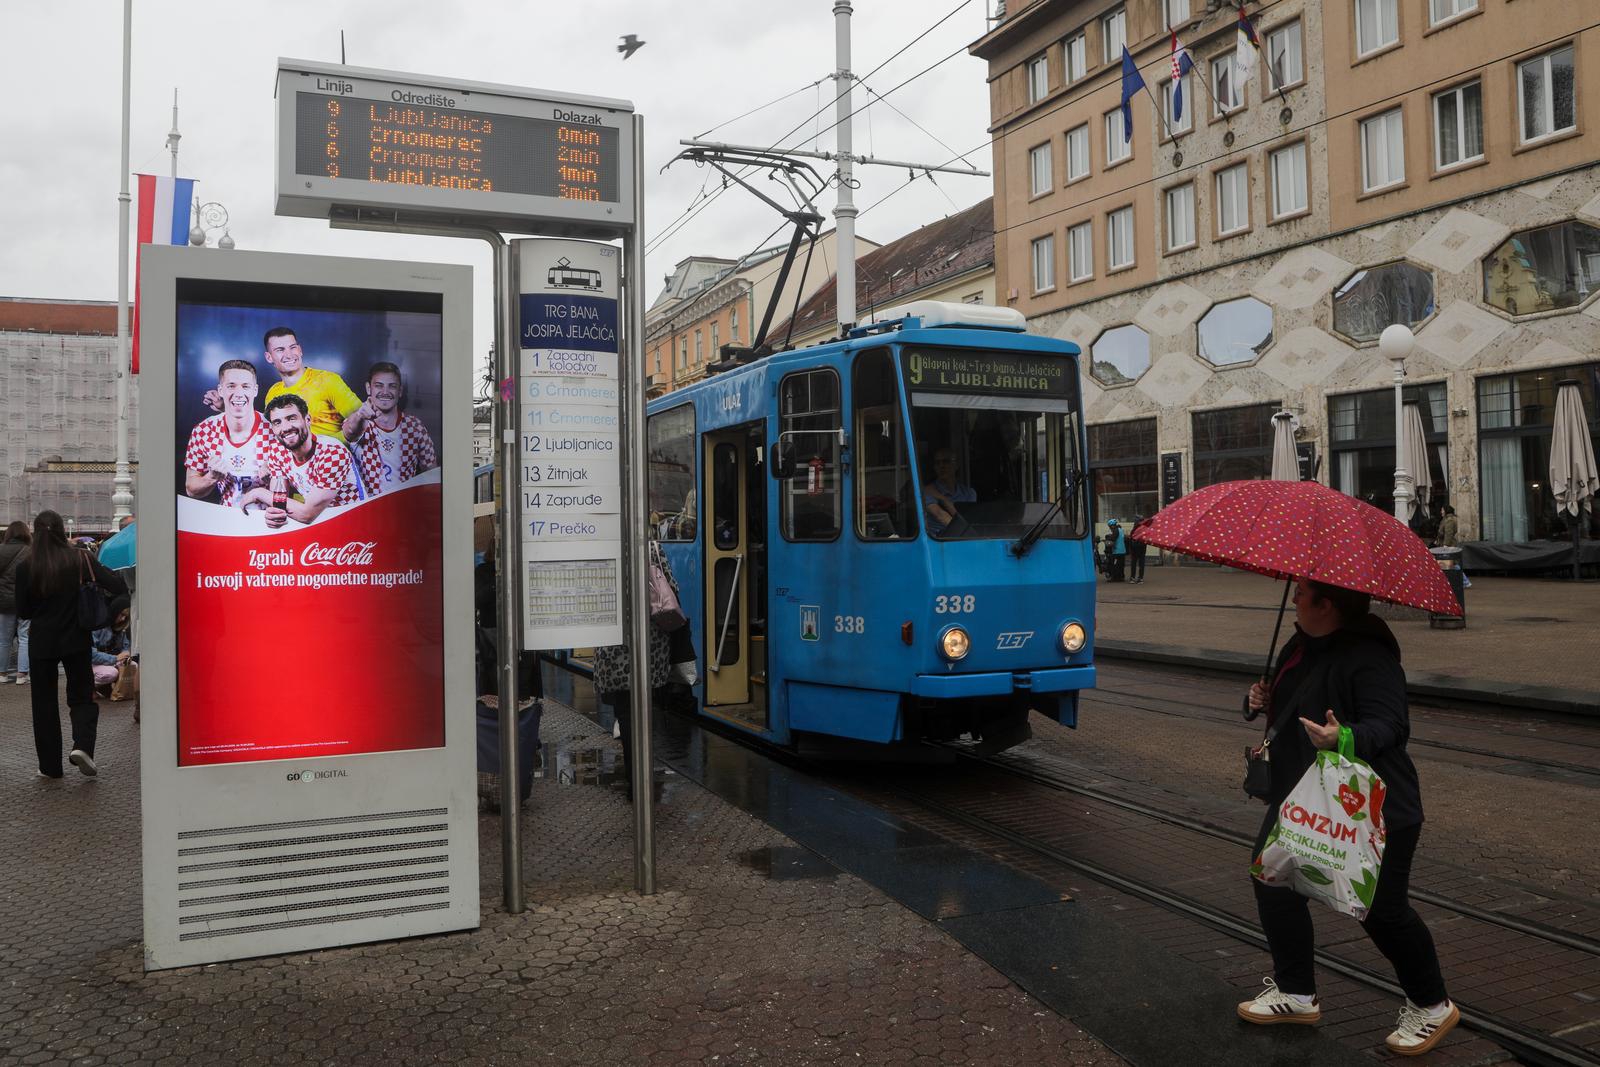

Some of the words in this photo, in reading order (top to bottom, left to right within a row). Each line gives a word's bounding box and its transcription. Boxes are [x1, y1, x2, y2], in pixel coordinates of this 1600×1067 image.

[316, 78, 353, 95] Linija
[391, 89, 456, 108] Odredište
[328, 100, 340, 117] 9
[370, 105, 493, 134] Ljubljanica
[553, 108, 602, 125] Dolazak
[328, 121, 340, 138] 6
[328, 141, 340, 158] 6
[328, 162, 340, 180] 9
[544, 304, 567, 318] TRG
[570, 305, 599, 320] BANA
[524, 324, 563, 338] JOSIPA
[566, 323, 615, 341] JELAČIĆA
[532, 351, 539, 367] 1
[546, 349, 595, 362] Zapadni
[549, 359, 598, 373] kolodvor
[910, 353, 923, 385] 9
[529, 382, 540, 398] 6
[546, 381, 616, 399] Črnomerec
[940, 372, 1049, 390] LJUBLJANICA
[528, 410, 542, 426] 11
[549, 410, 617, 426] Črnomerec
[523, 435, 541, 452] 12
[545, 438, 613, 452] Ljubljanica
[524, 466, 541, 482] 13
[547, 464, 588, 482] Žitnjak
[524, 493, 541, 509] 14
[529, 521, 545, 536] 17
[550, 522, 596, 535] Prečko
[249, 549, 294, 570] Zgrabi
[300, 541, 378, 567] Coca-Cola
[197, 572, 202, 588] i
[204, 571, 243, 591] osvoji
[246, 573, 295, 588] vatrene
[297, 570, 368, 590] nogometne
[370, 569, 424, 588] nagrade!
[934, 594, 976, 614] 338
[834, 615, 865, 634] 338
[996, 631, 1035, 650] ZET
[314, 769, 349, 779] DIGITAL
[1280, 801, 1358, 844] KONZUM
[1280, 825, 1347, 860] RECIKLIRAM
[1311, 854, 1346, 871] PRIRODU
